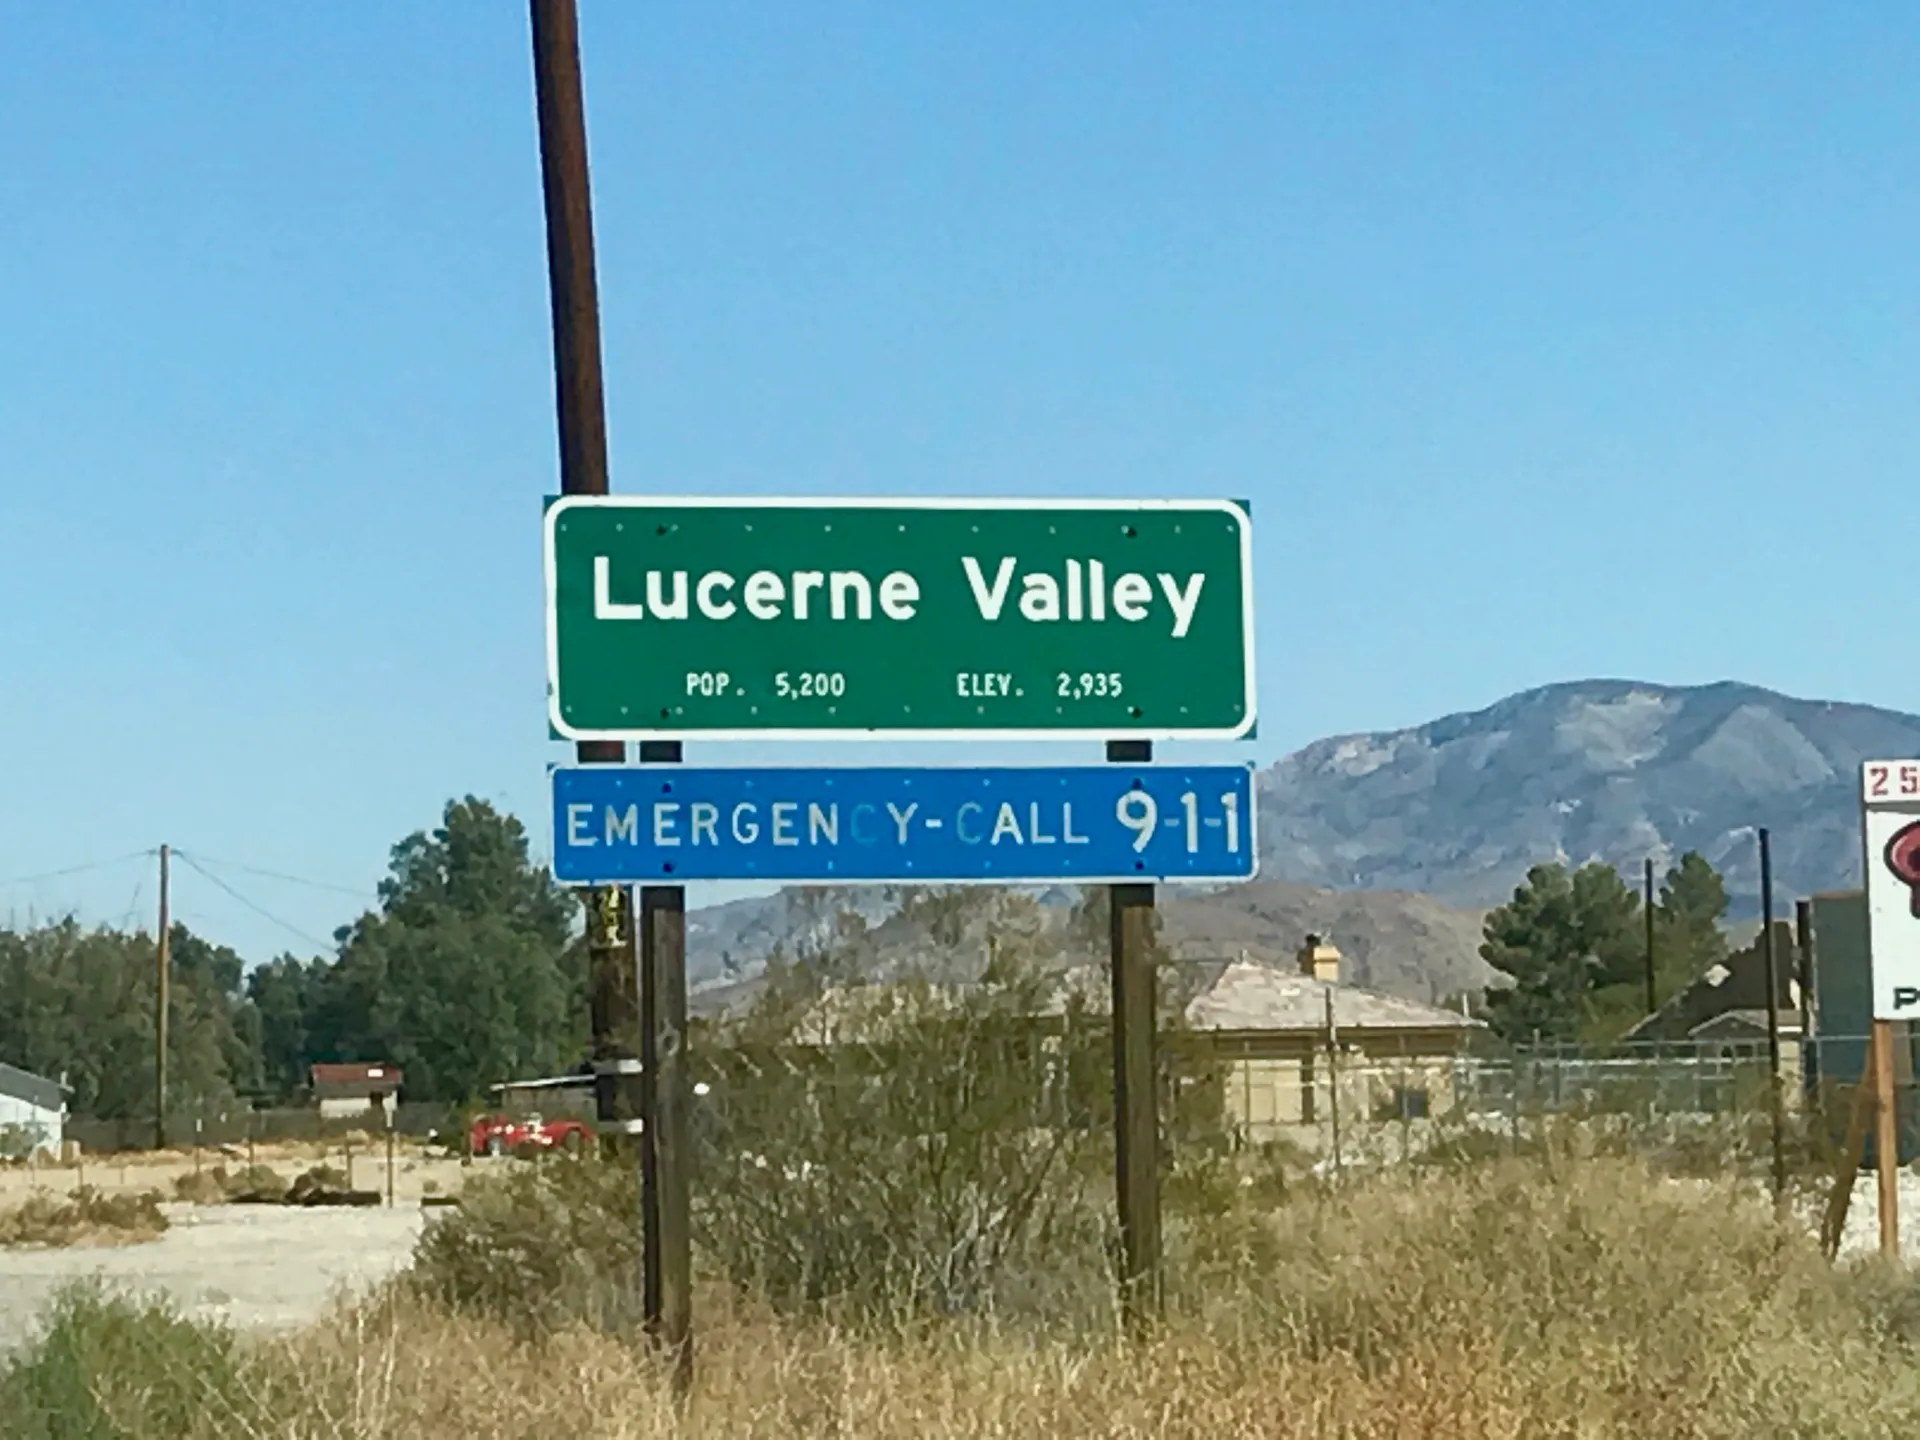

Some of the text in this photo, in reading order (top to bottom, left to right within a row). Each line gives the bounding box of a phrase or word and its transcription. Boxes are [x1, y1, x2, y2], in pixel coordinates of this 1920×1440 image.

[593, 556, 1206, 638] Lucerne Valley
[686, 672, 1123, 700] POP. 5,200 ELEV. 2,935
[1115, 790, 1239, 853] 9-1-1
